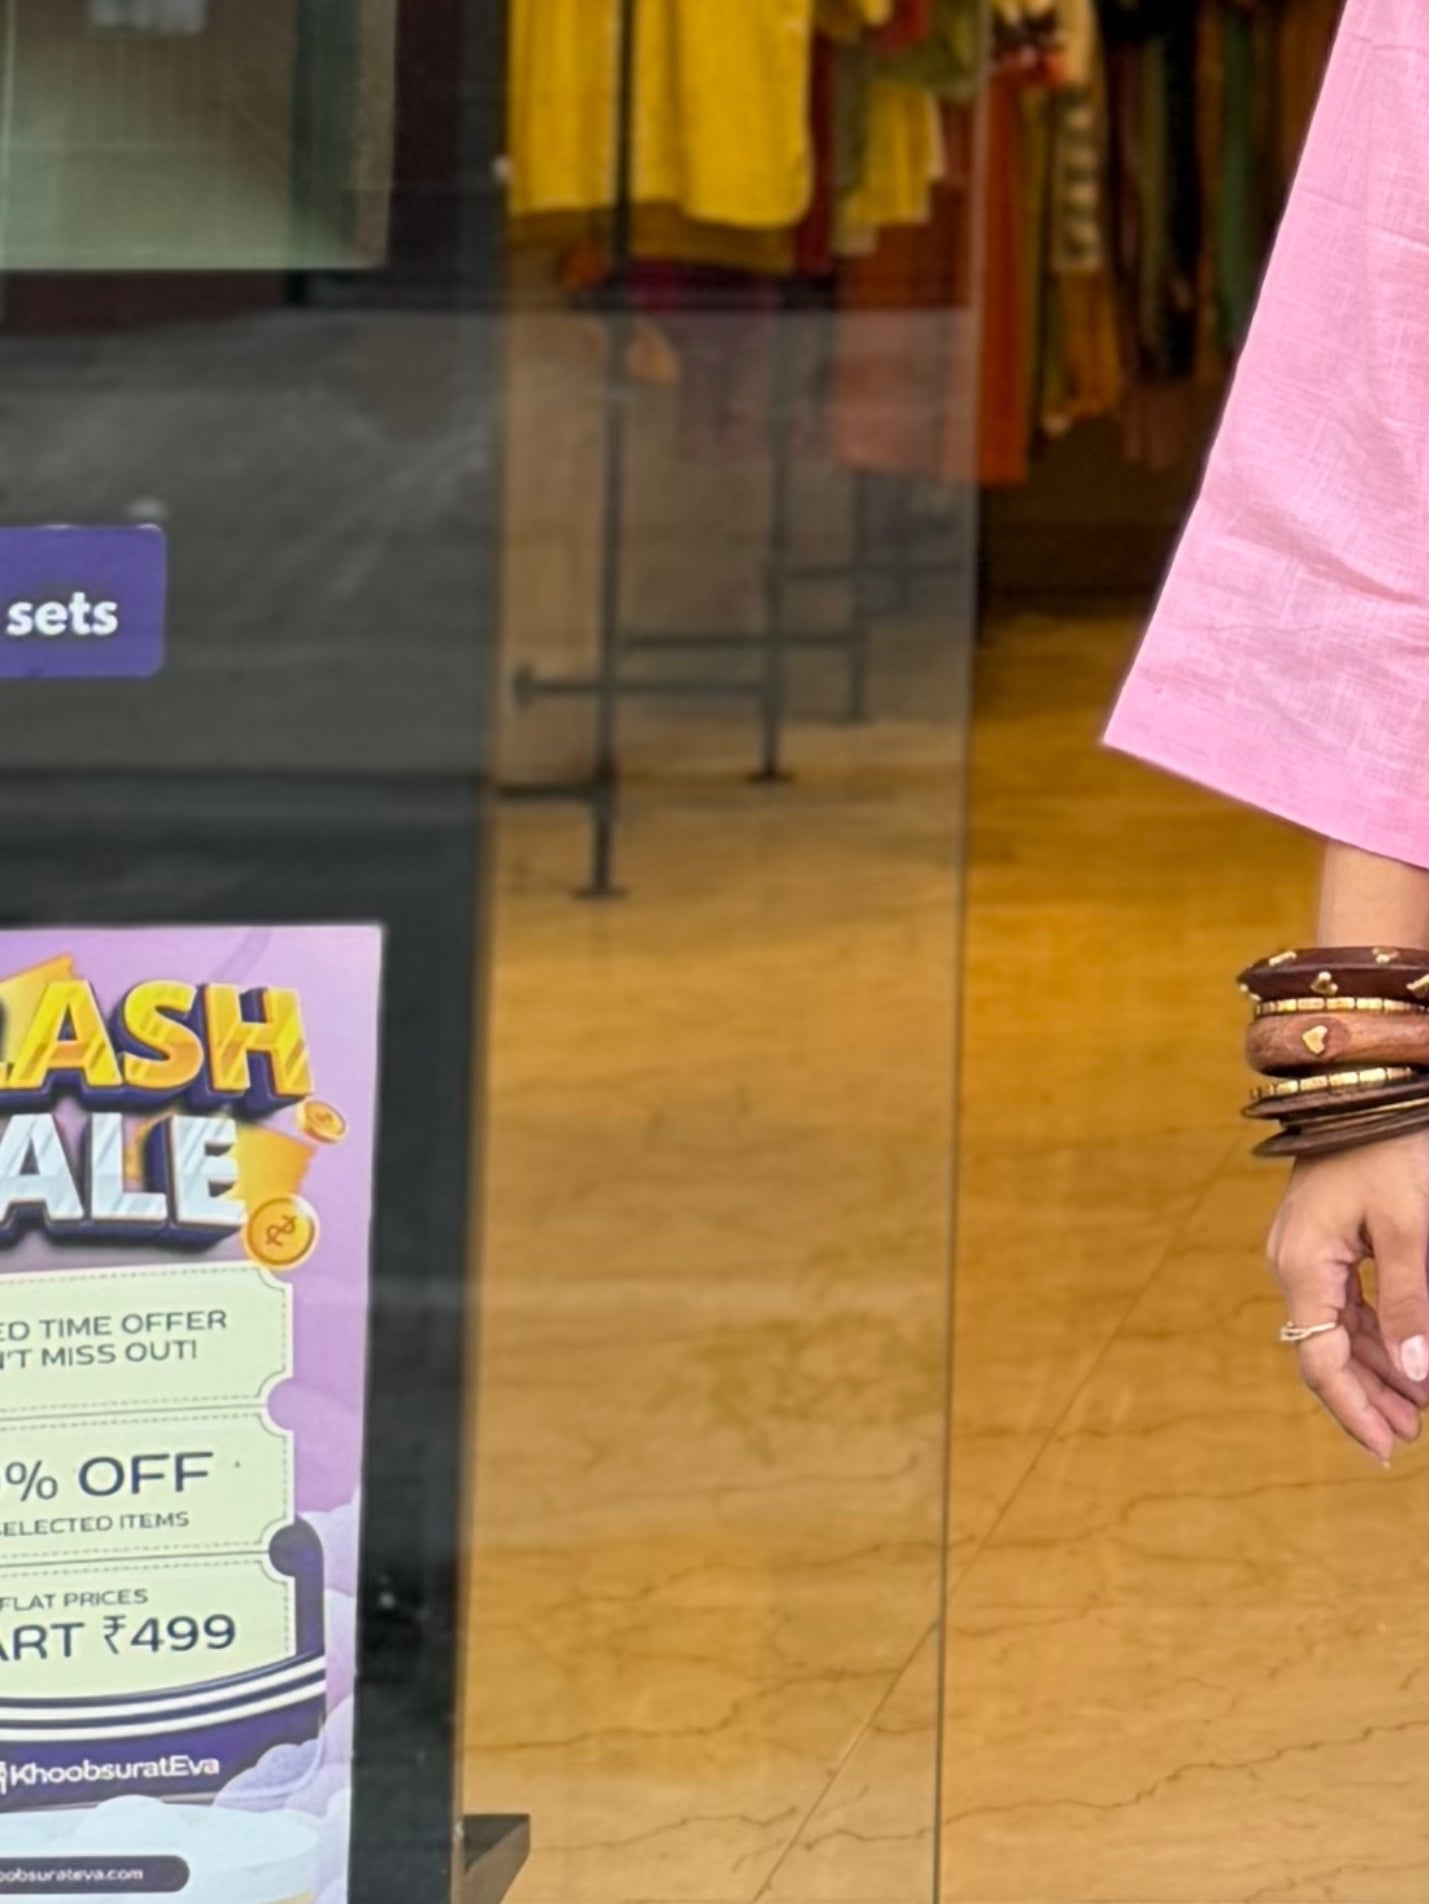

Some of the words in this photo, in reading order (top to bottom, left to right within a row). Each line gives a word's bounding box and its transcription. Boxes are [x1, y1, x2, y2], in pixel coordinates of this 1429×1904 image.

[6, 591, 119, 636] sets
[0, 979, 313, 1097] ASH
[39, 1315, 112, 1339] TIME
[121, 1309, 227, 1335] OFFER
[0, 1348, 33, 1371] 'T
[41, 1344, 117, 1367] MISS
[125, 1339, 197, 1363] OUT!
[78, 1451, 214, 1497] OFF
[0, 1515, 113, 1537] ELECTED
[120, 1511, 190, 1530] ITEMS
[63, 1587, 148, 1609] PRICES
[0, 1622, 85, 1662] RT
[102, 1613, 236, 1655] ₹499
[10, 1755, 219, 1786] KhoobsuratEva
